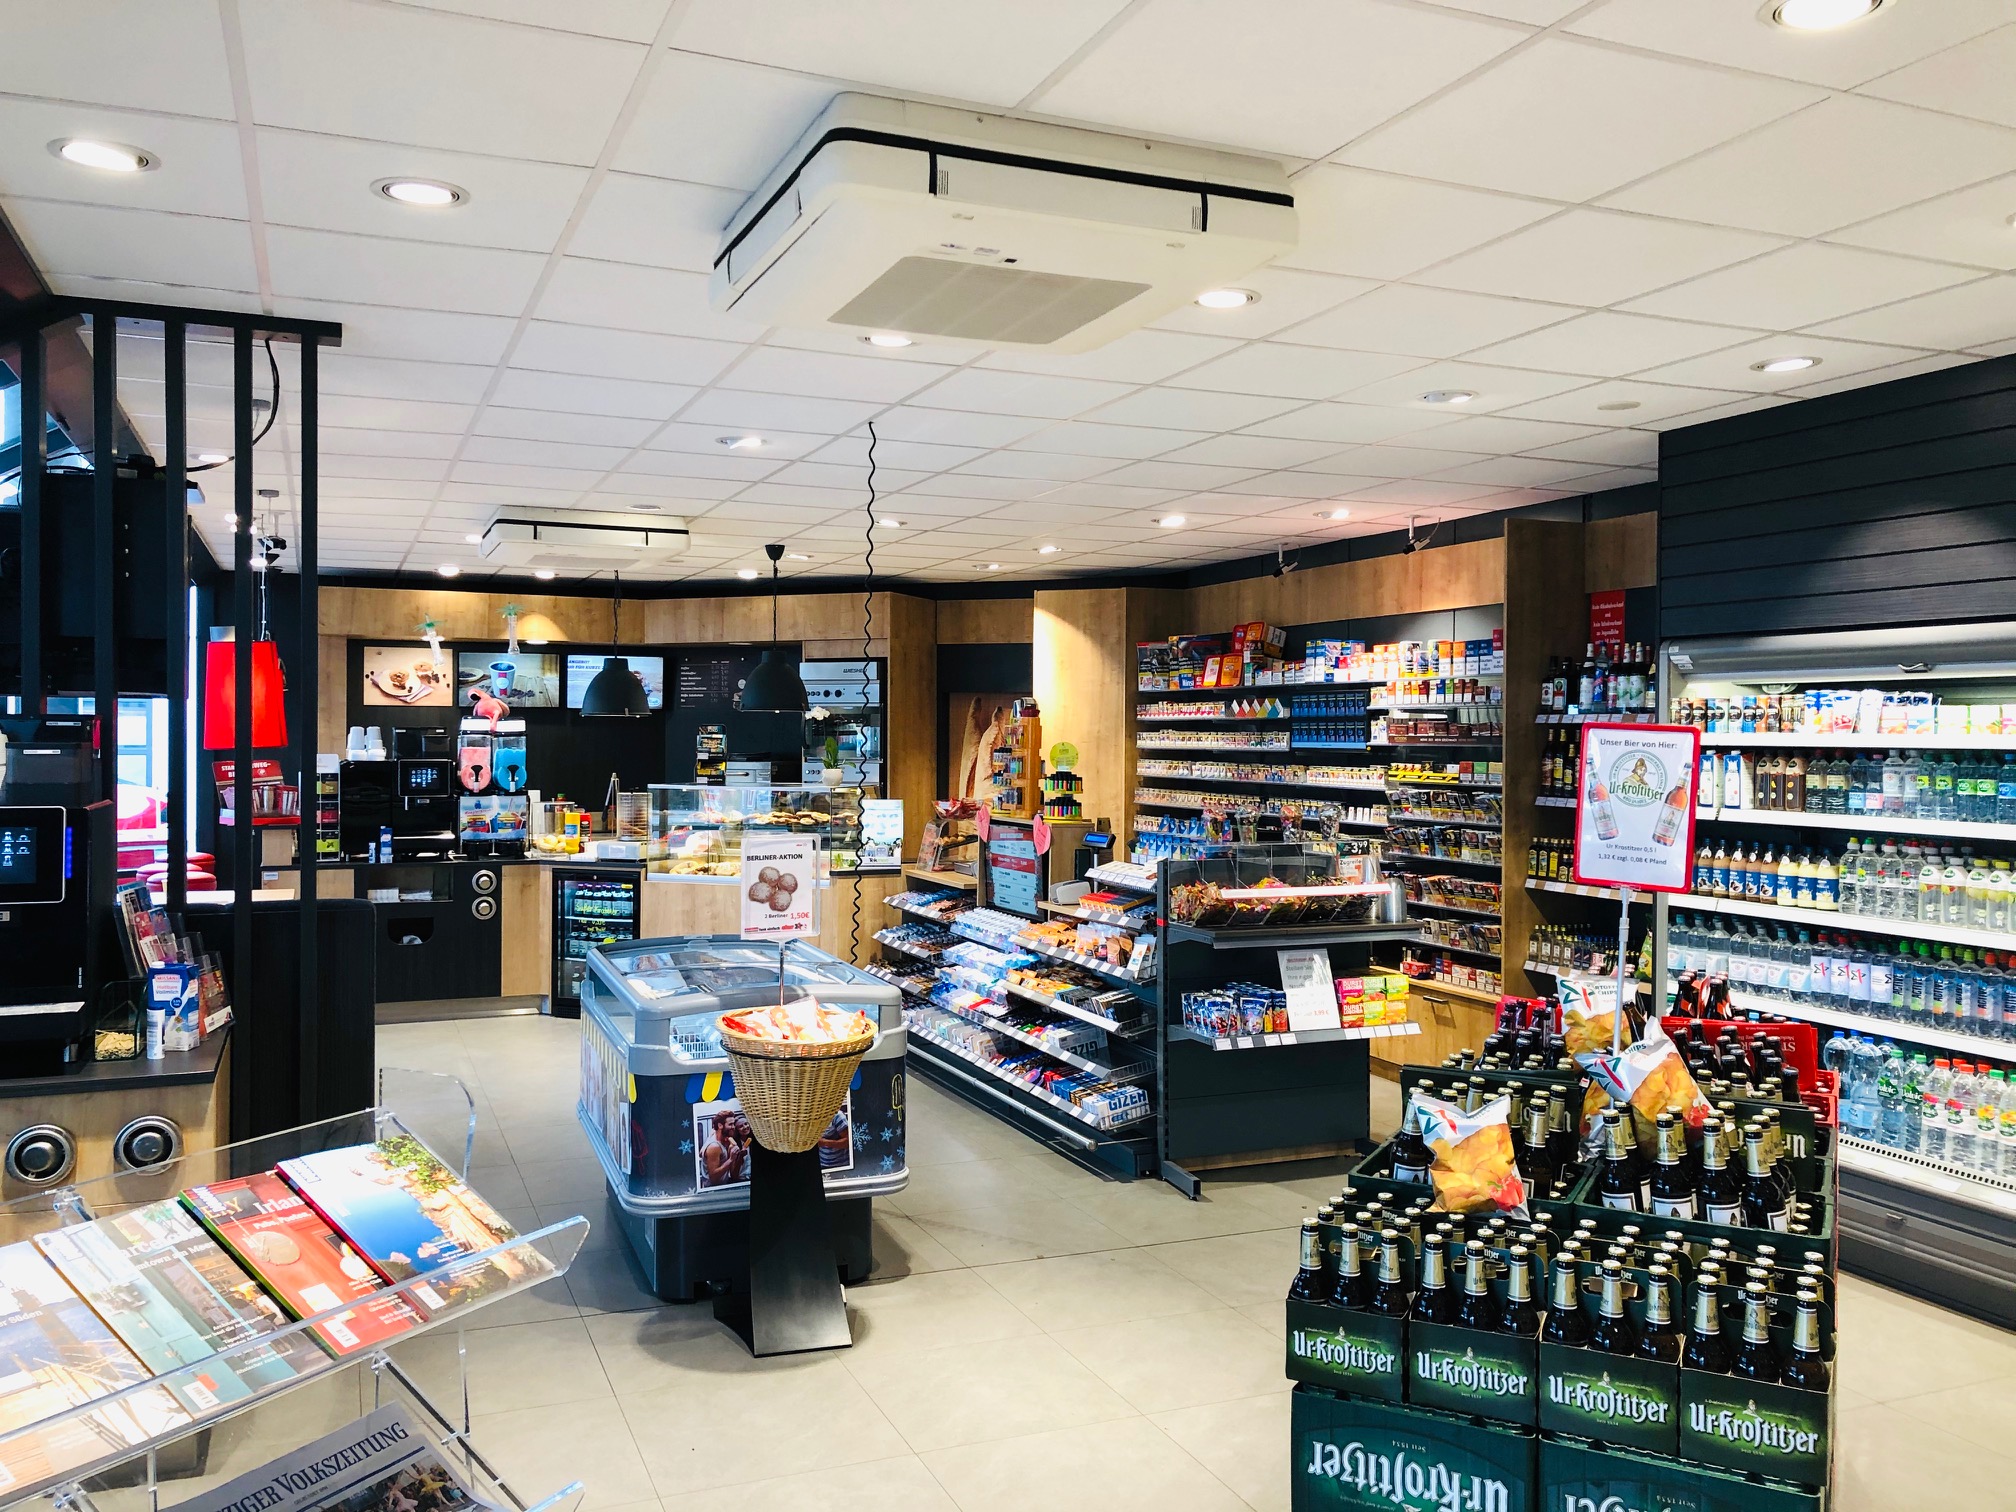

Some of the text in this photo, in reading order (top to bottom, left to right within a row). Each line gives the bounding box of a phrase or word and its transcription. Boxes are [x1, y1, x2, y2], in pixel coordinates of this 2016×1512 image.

[1600, 738, 1622, 746] Unser
[1624, 739, 1640, 747] Bier
[1658, 741, 1678, 749] Hier:
[746, 853, 803, 862] BERLINER-AKTION
[1624, 1043, 1647, 1056] CHIPS
[1108, 1090, 1147, 1112] GIZEH
[252, 1195, 305, 1215] Irlan
[9, 1309, 44, 1325] Süden
[272, 1421, 410, 1495] VOLKSZEITUNG
